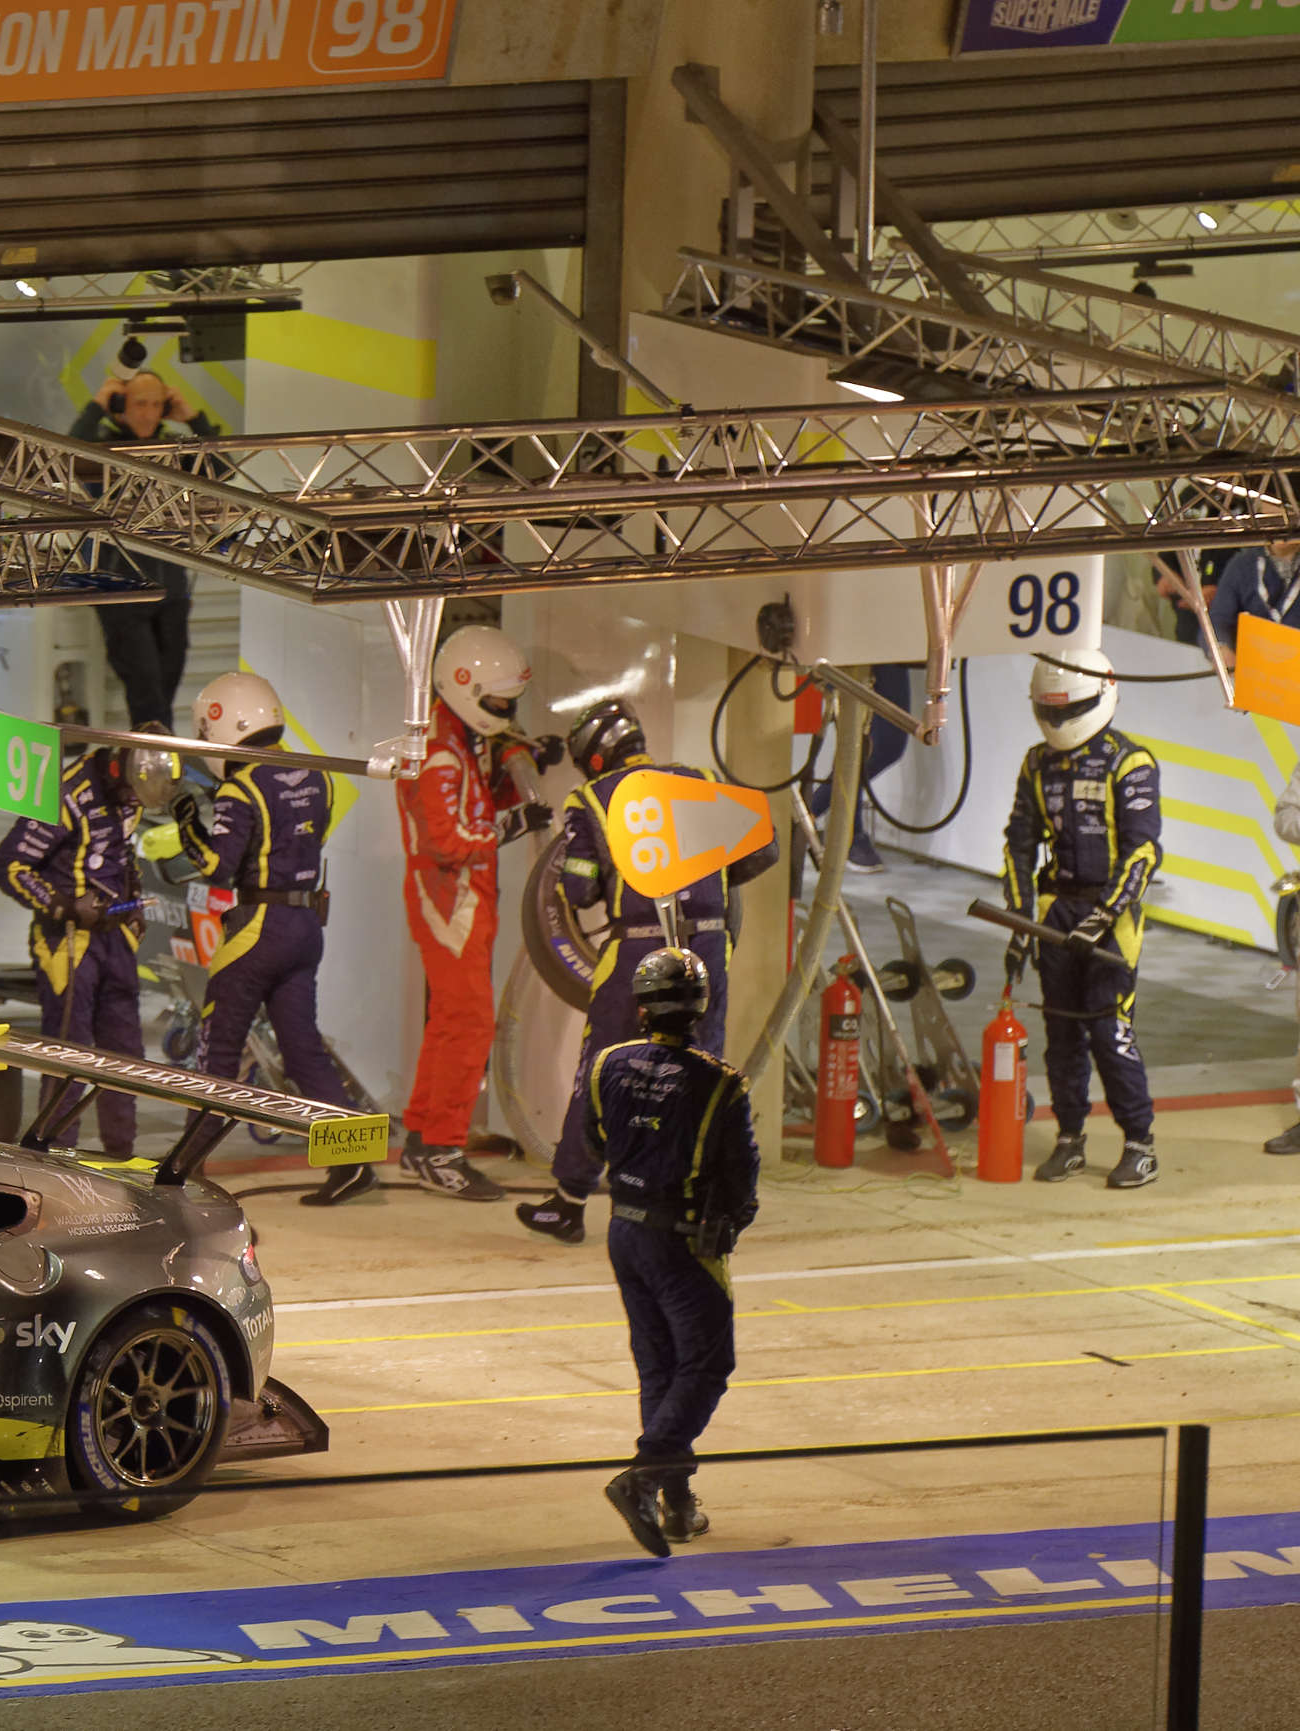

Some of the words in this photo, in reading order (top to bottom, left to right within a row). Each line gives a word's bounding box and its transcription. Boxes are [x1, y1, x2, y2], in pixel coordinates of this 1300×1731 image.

[76, 0, 290, 72] MARTIN
[327, 0, 428, 58] 98
[1007, 570, 1082, 639] 98
[7, 735, 52, 808] 97
[624, 796, 671, 875] 98
[6, 1041, 117, 1068] ASTON
[111, 1064, 229, 1099] MARTIN
[218, 1085, 350, 1121] RACING
[314, 1126, 386, 1146] HACKETT
[331, 1144, 368, 1156] LONDON
[15, 1314, 77, 1354] sky
[242, 1308, 274, 1342] TOTAL
[238, 1546, 1300, 1650] MICHELIN
